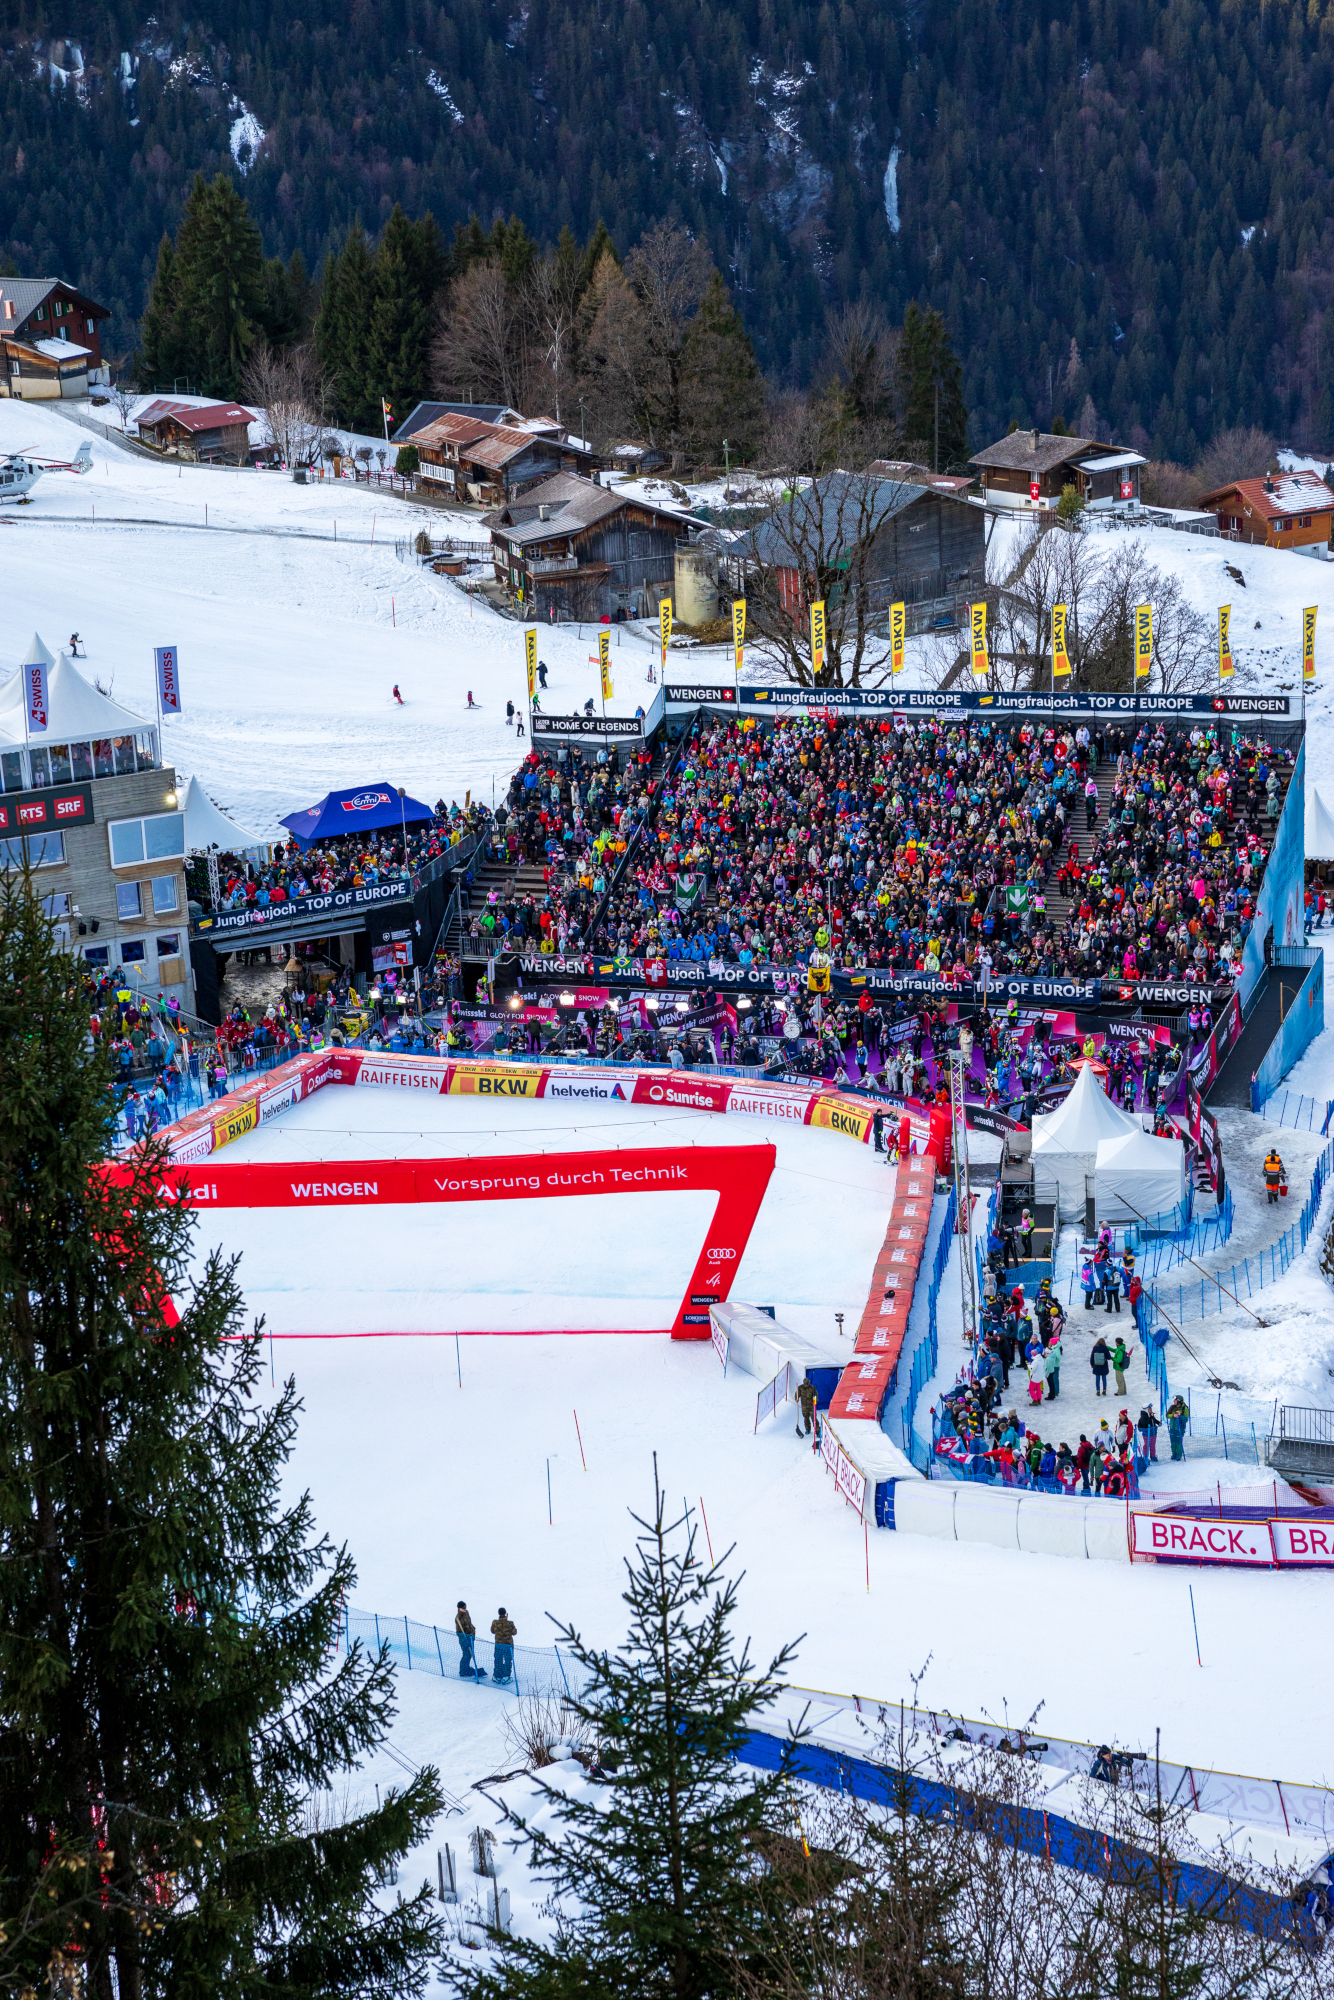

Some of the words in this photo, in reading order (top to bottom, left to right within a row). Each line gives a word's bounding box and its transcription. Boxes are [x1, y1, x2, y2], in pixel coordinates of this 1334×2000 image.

[815, 609, 823, 650] BKW
[894, 610, 902, 651] BKW
[973, 610, 983, 651] BKW
[1055, 611, 1064, 652] BKW
[1139, 613, 1150, 655] BKW
[1306, 613, 1314, 656] BKW
[163, 651, 173, 690] SWISS
[32, 668, 42, 708] SWISS
[669, 688, 722, 700] WENGEN
[770, 691, 850, 705] Jungfraujoch
[860, 693, 886, 705] TOP
[888, 694, 906, 705] OF
[909, 694, 961, 706] EUROPE
[995, 695, 1077, 709] Jungfraujoch
[1088, 697, 1115, 708] TOP
[1117, 698, 1136, 709] OF
[1139, 698, 1193, 709] EUROPE
[1227, 699, 1285, 711] WENGEN
[552, 720, 580, 730] HOME
[582, 721, 595, 730] OF
[597, 722, 639, 732] LEGENDS
[57, 801, 81, 814] SRF
[354, 796, 377, 806] Emmi
[20, 806, 43, 820] RTS
[215, 902, 297, 928] Jungfrujoch
[306, 896, 332, 911] TOP
[335, 894, 352, 907] OF
[355, 882, 406, 902] EUROPE
[520, 958, 585, 974] WENGEN
[748, 971, 769, 983] OF
[1008, 982, 1029, 994] OF
[1033, 983, 1094, 998] EUROPE
[1137, 986, 1211, 1004] WENGEN
[361, 1070, 439, 1089] RAIFFEISEN
[479, 1077, 529, 1095] BKW
[551, 1084, 608, 1099] helvetia
[666, 1088, 713, 1107] Sunrise
[262, 1098, 290, 1121] helvetia
[731, 1098, 802, 1119] RAIFFEISEN
[228, 1113, 252, 1140] BKW
[831, 1112, 860, 1137] BKW
[434, 1175, 540, 1192] Vorsprung
[547, 1170, 604, 1185] durch
[609, 1165, 688, 1182] Technik
[290, 1182, 378, 1198] WENGEN
[840, 1466, 861, 1503] BRACK.
[1151, 1521, 1257, 1556] BRACK.
[1288, 1528, 1334, 1555] BR
